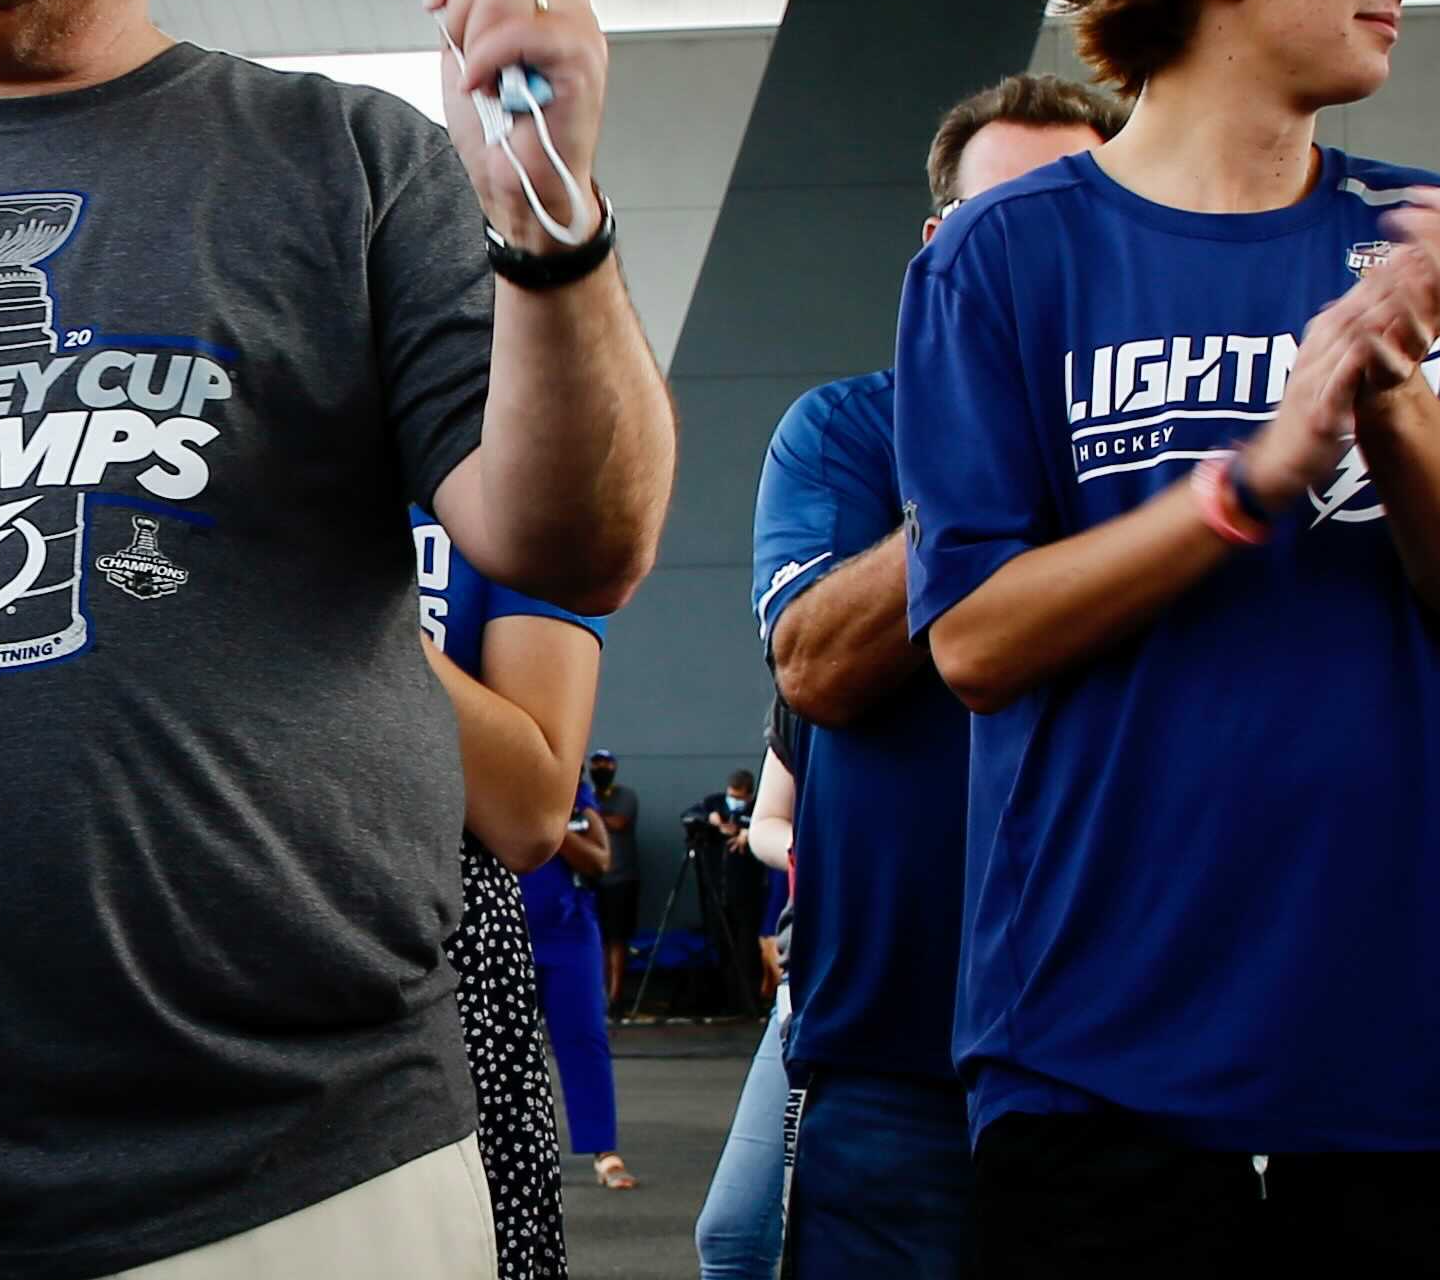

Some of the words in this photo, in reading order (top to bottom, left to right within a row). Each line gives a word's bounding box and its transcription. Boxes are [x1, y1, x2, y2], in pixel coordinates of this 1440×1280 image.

[63, 329, 92, 348] 20
[77, 351, 233, 418] CUP
[1079, 426, 1175, 463] HOCKEY
[99, 557, 185, 580] CHAMPIONS
